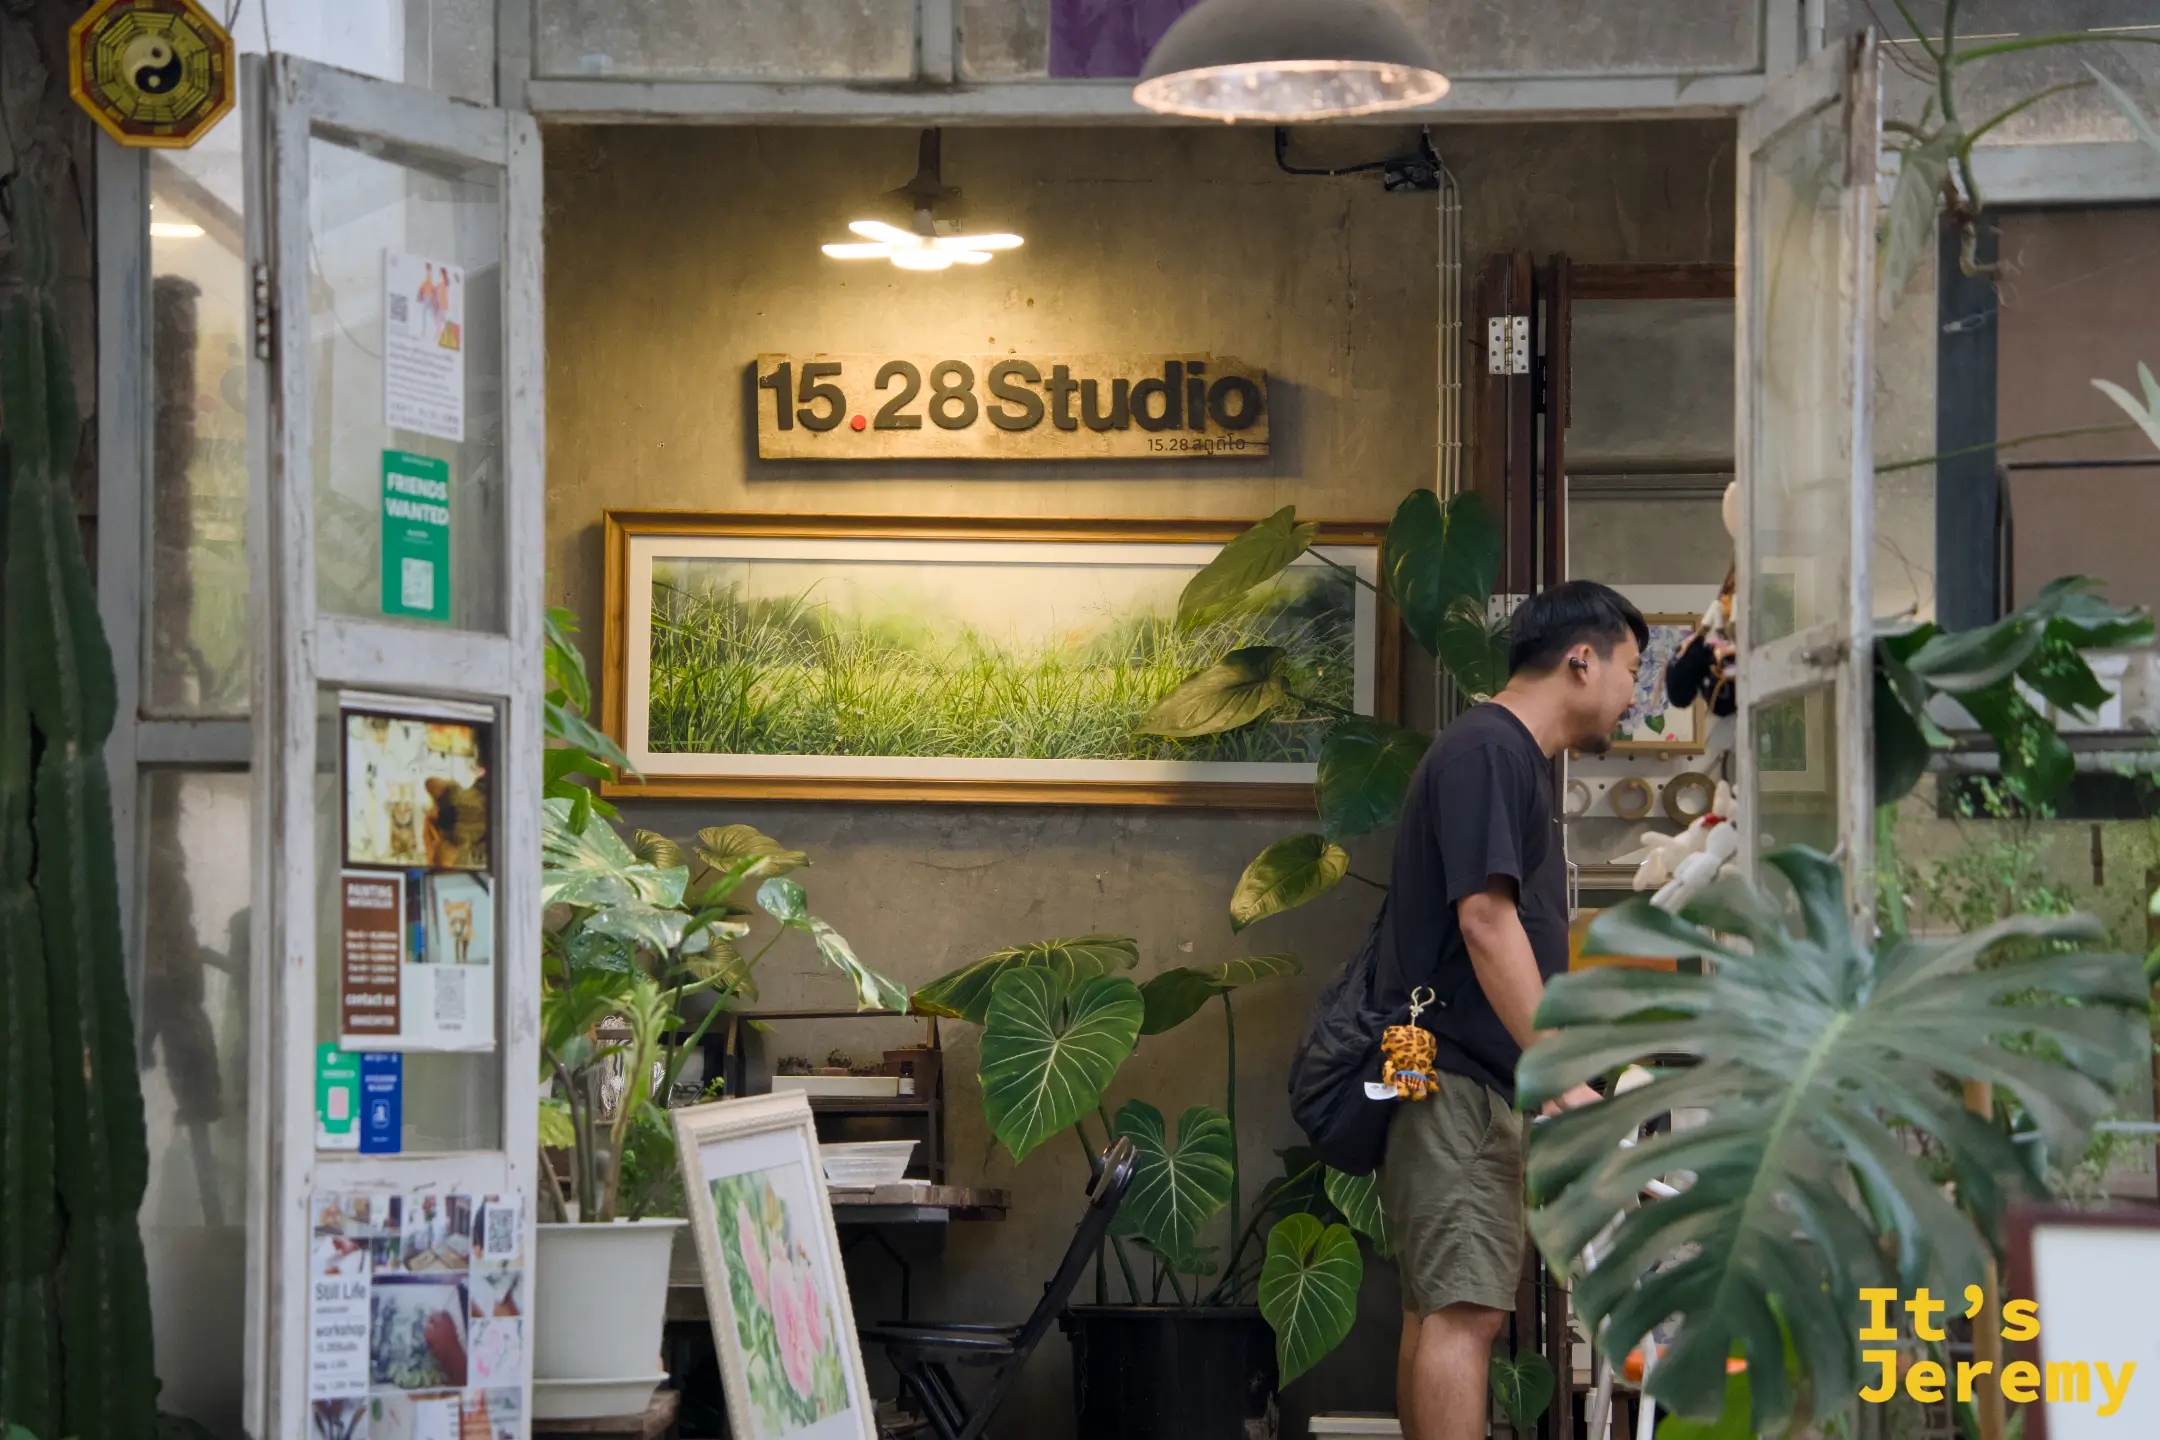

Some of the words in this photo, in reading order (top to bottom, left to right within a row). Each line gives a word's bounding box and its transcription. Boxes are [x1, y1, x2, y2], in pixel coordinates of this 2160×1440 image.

[759, 359, 1262, 432] 15.28Studio
[386, 471, 448, 501] FRIENDS
[386, 497, 449, 527] WANTED
[315, 1282, 340, 1302] Still
[343, 1282, 366, 1301] Life
[315, 1320, 366, 1339] workshop
